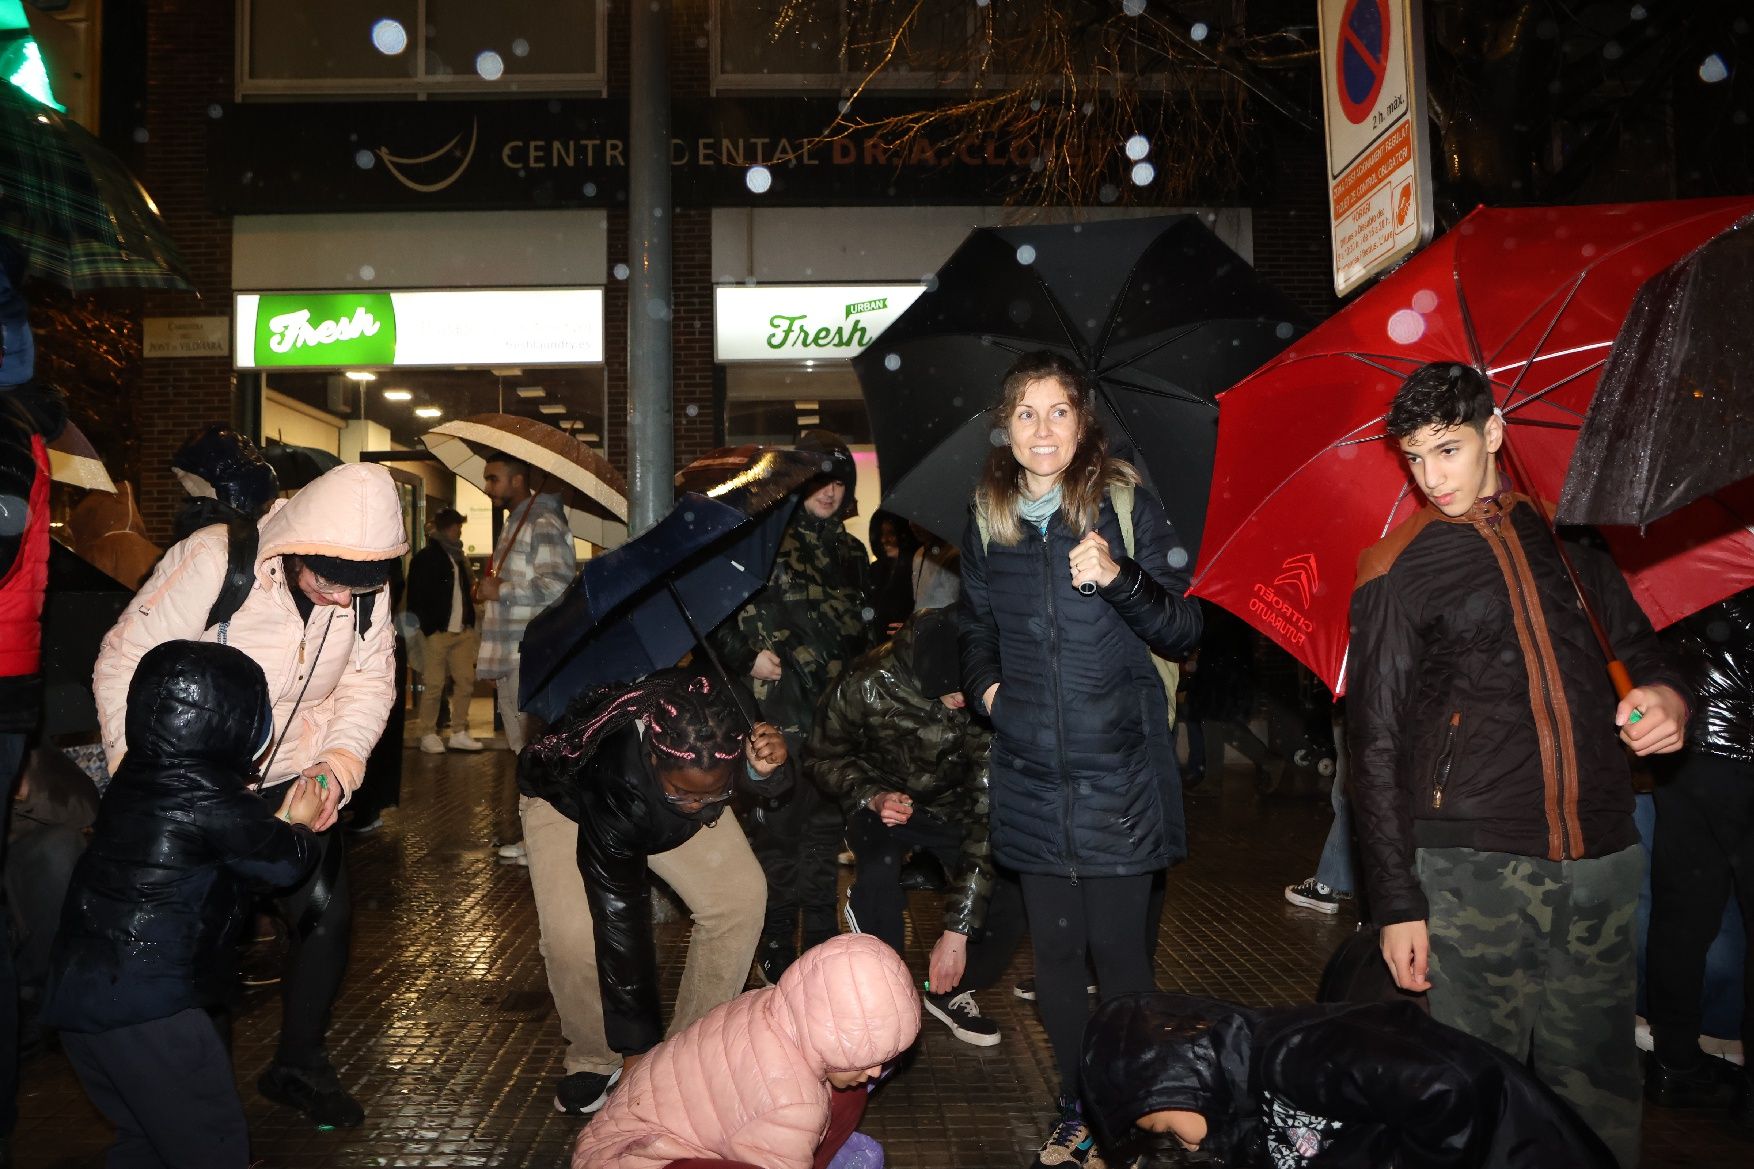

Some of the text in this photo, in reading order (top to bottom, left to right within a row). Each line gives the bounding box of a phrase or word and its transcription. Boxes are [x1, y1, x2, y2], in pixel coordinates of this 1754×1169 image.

[1373, 95, 1404, 130] 2 h. màx.
[501, 139, 626, 168] CENTR
[669, 137, 820, 166] DENTAL
[850, 300, 884, 314] URBAN
[269, 306, 381, 353] Fresh
[767, 314, 873, 350] Fresh
